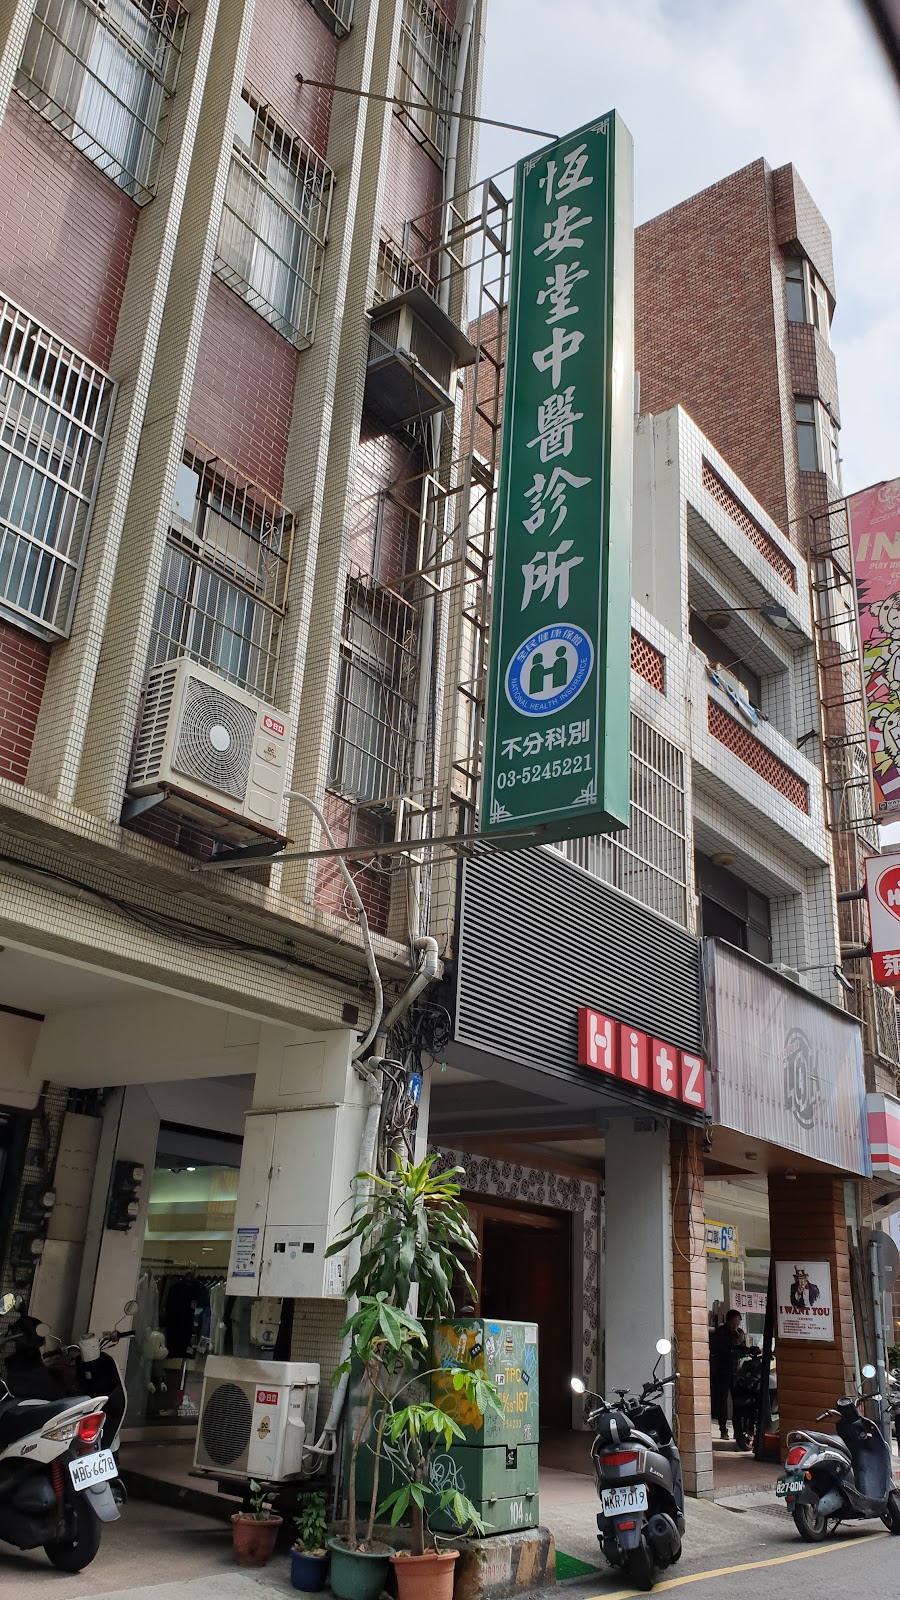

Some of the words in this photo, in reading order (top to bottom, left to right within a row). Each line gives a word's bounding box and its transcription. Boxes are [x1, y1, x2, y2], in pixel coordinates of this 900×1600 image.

[517, 629, 583, 663] 全民健康保險
[509, 677, 529, 709] NATIONAL
[529, 698, 558, 711] HEALTH
[560, 656, 588, 701] INSURANCE
[501, 718, 590, 760] 不分科別
[497, 753, 593, 790] 03-5245221
[779, 1305, 784, 1314] I
[784, 1305, 811, 1316] WANT
[811, 1307, 830, 1317] YOU
[504, 1367, 521, 1383] TPC
[510, 1500, 523, 1525] 104
